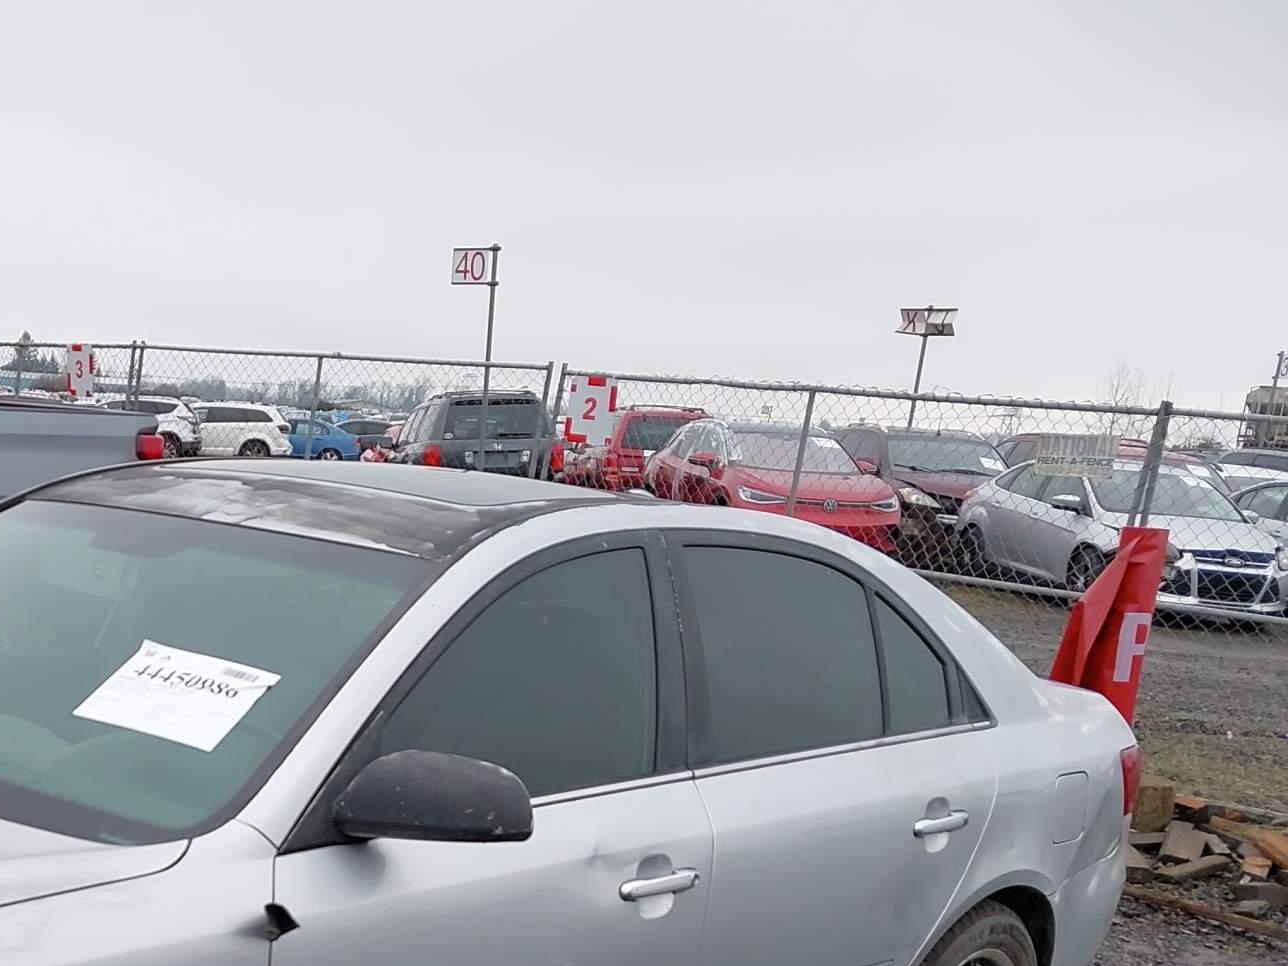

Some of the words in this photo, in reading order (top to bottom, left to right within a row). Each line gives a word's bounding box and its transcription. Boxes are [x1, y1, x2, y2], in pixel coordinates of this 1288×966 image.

[455, 251, 486, 281] 40
[75, 359, 84, 379] 3
[582, 396, 598, 421] 2
[1036, 456, 1115, 467] RENT-A-FENCE
